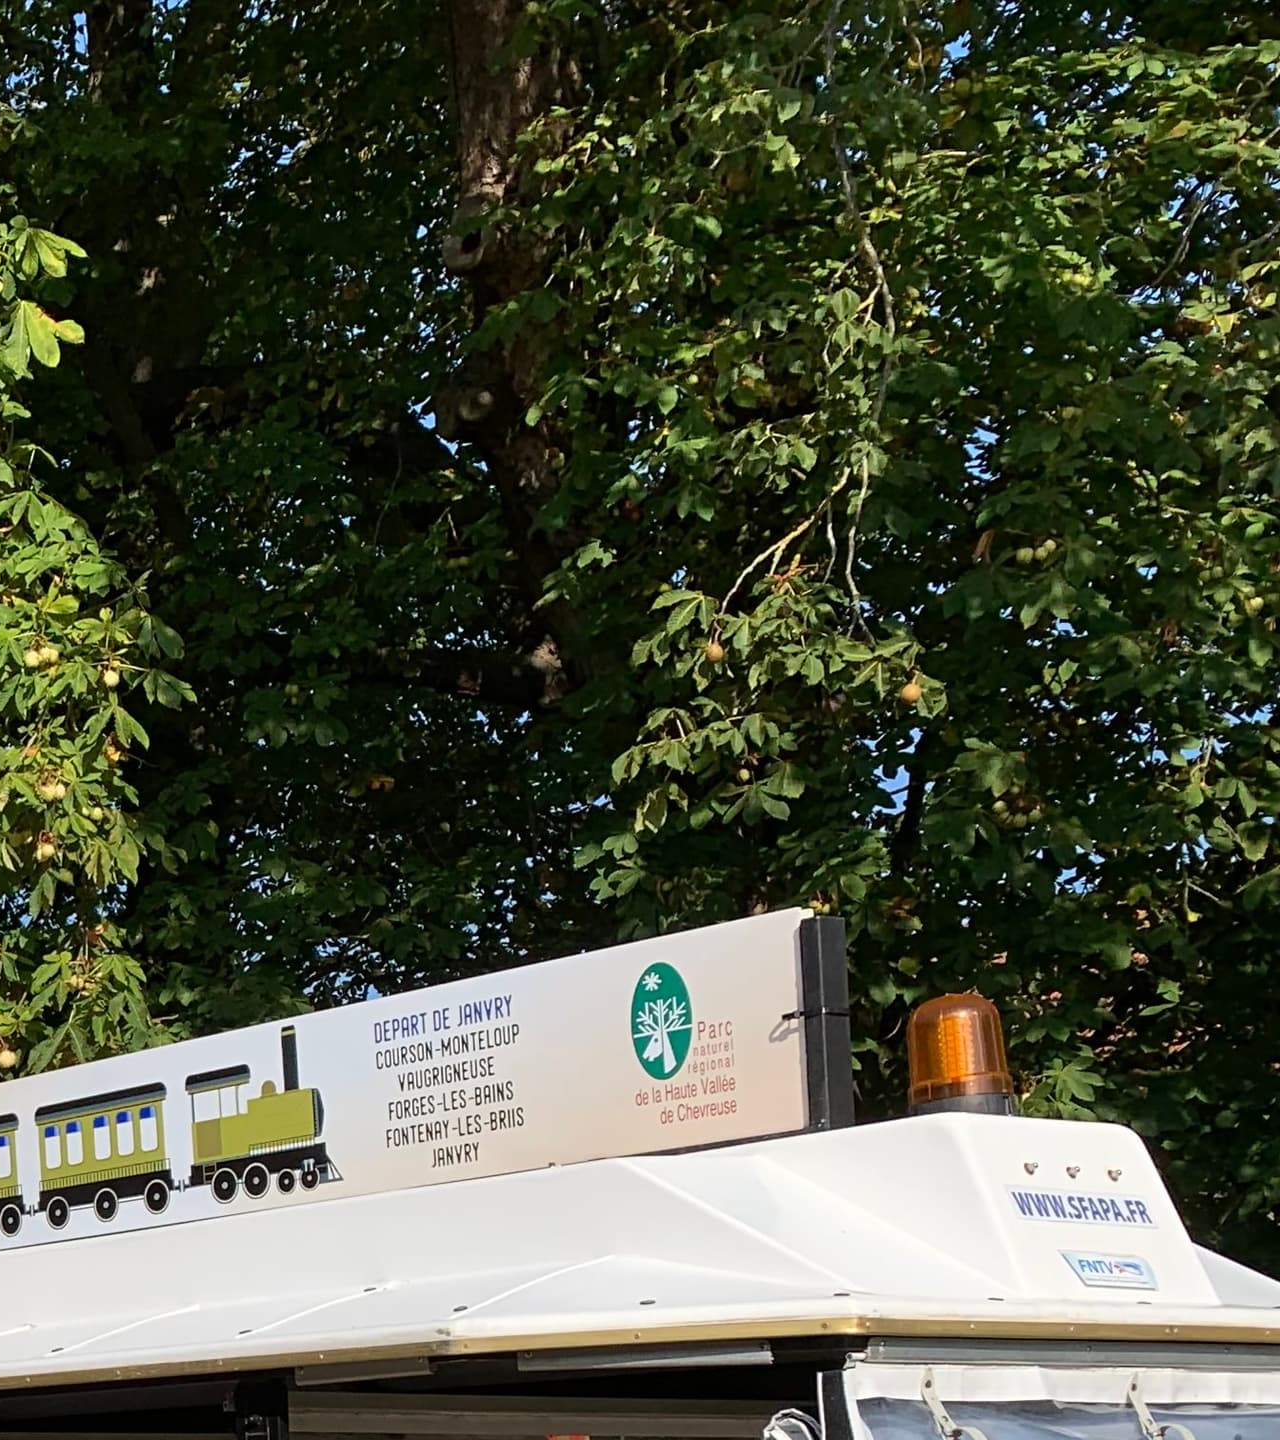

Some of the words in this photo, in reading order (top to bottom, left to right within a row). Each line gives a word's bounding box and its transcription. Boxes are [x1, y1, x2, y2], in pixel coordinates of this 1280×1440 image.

[374, 1012, 427, 1044] DEPART
[433, 1008, 451, 1032] DE
[457, 995, 512, 1028] JANVRY
[697, 1020, 733, 1040] Parc
[376, 1024, 520, 1070] COURSON-MONTELOUP
[693, 1037, 734, 1057] naturel
[398, 1056, 495, 1092] VAUGRIGNEUSE
[388, 1081, 514, 1121] FORGES-LES-BAINS
[635, 1090, 649, 1106] de
[652, 1087, 662, 1104] la
[665, 1083, 698, 1101] Haute
[700, 1075, 736, 1095] Vallée
[386, 1107, 525, 1148] FONTENAY-LES-BRIIS
[660, 1107, 674, 1124] de
[677, 1099, 737, 1122] Chevreuse
[432, 1142, 480, 1168] JANVRY
[1011, 1191, 1153, 1224] WWW.SFAPA.FR
[1078, 1259, 1114, 1274] FNTV
